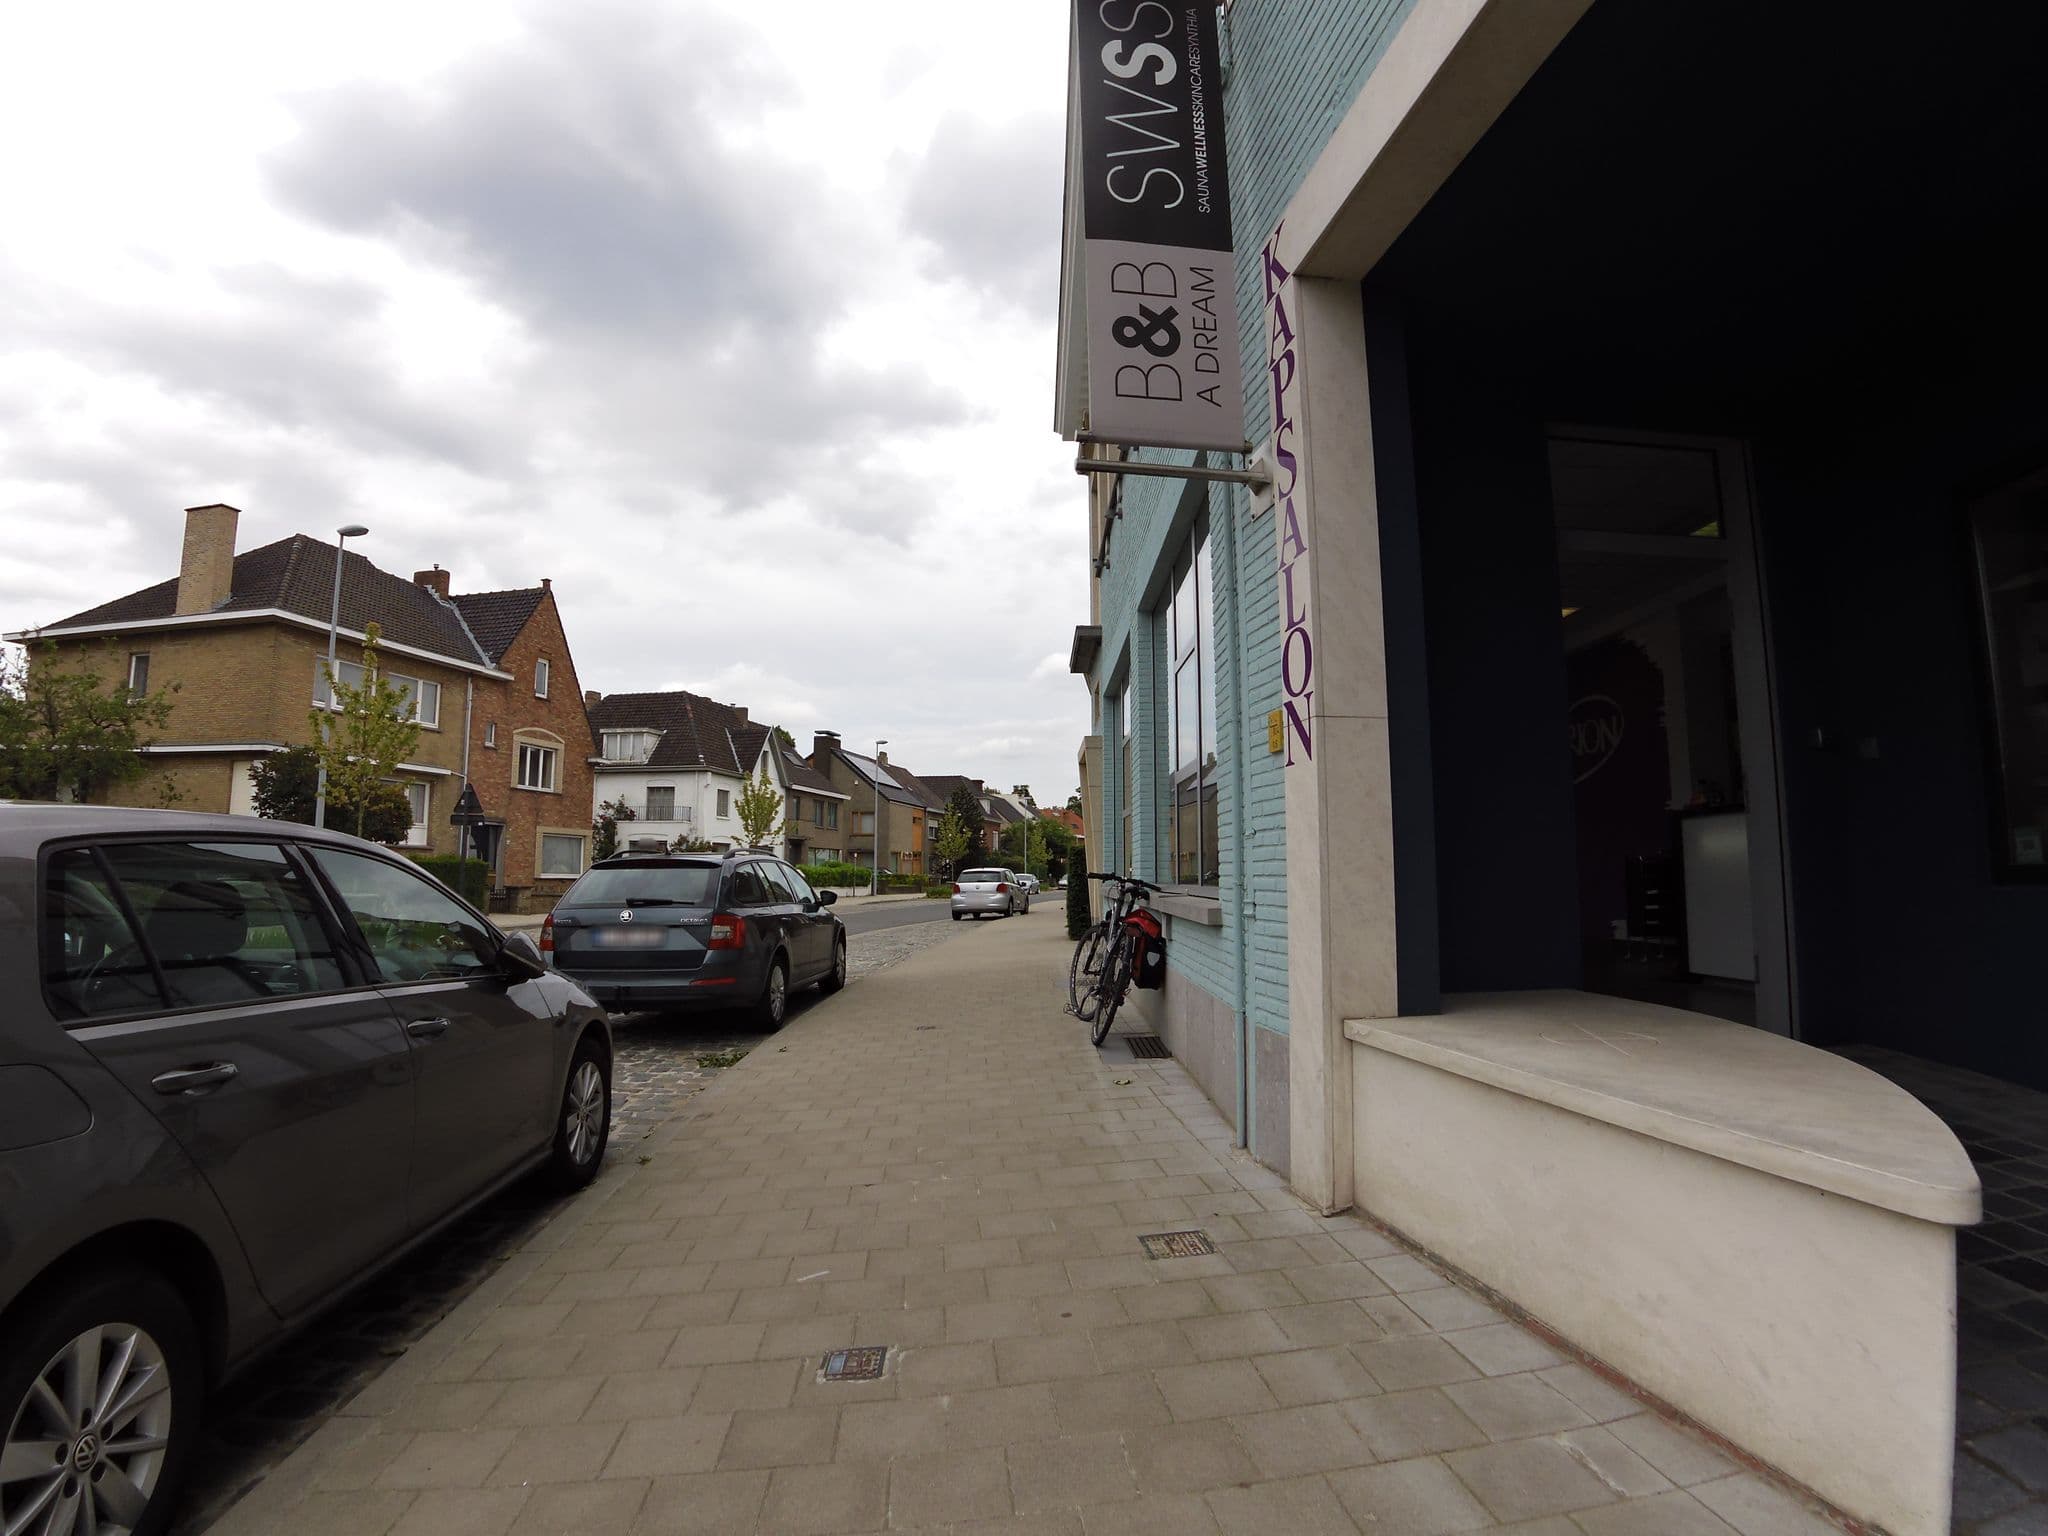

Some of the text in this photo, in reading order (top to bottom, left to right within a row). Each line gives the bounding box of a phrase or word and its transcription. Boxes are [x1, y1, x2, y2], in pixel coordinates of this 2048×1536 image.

[1100, 0, 1184, 208] SWSS
[1111, 262, 1183, 401] B&B
[1189, 266, 1222, 408] A DREAM
[1262, 219, 1313, 767] KAPSALON
